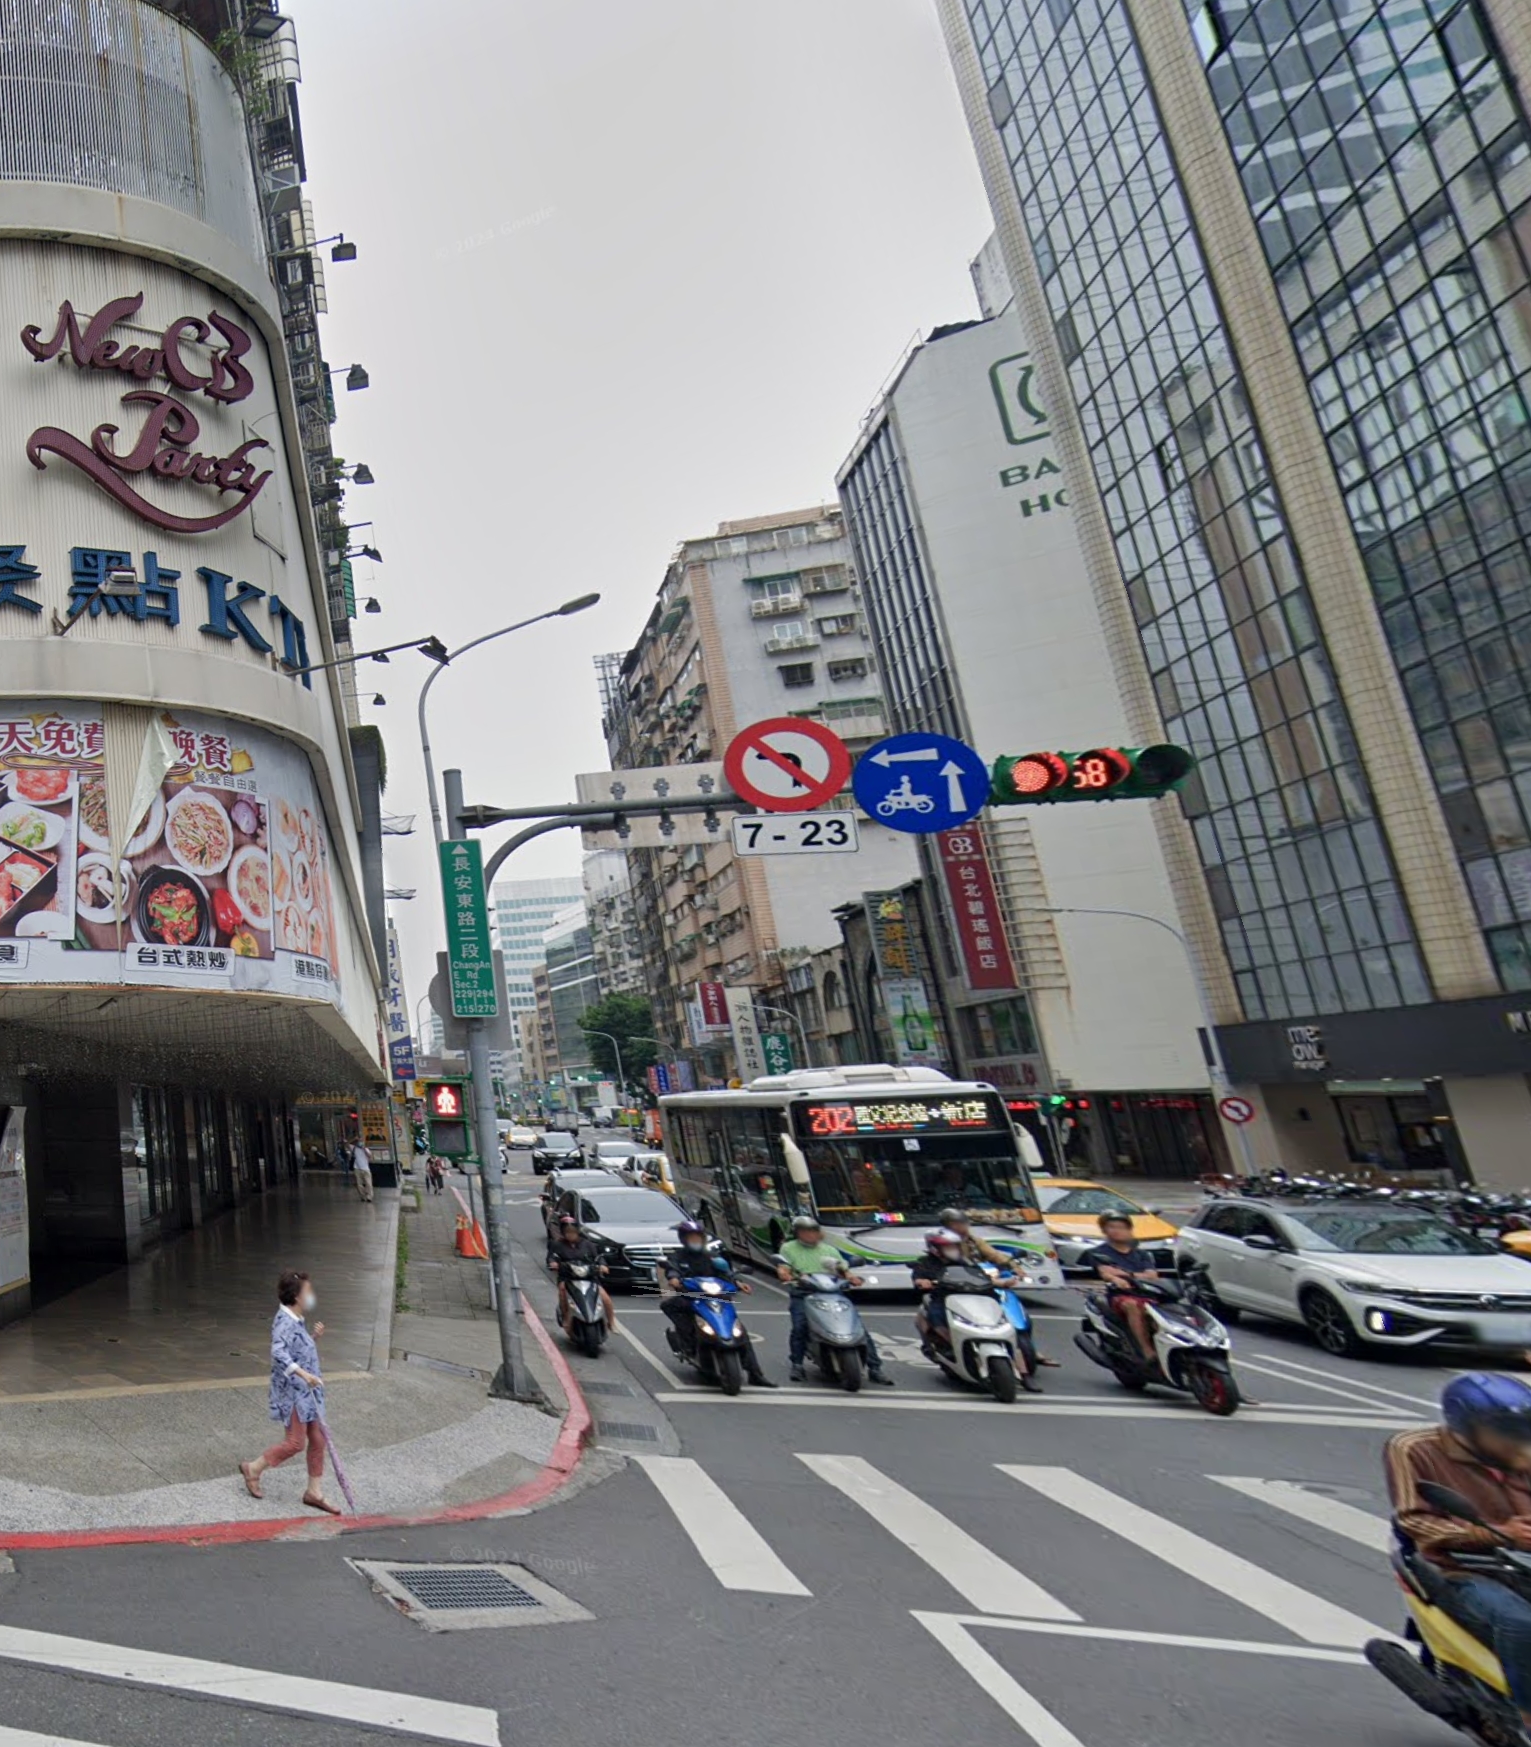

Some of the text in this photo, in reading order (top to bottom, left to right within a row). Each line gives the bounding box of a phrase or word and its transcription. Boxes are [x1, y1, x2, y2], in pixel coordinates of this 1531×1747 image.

[26, 389, 274, 534] Party
[452, 856, 480, 958] 長安東路二段
[958, 866, 998, 968] 台北碧瑤飯店
[137, 946, 229, 969] 台式熱炒
[452, 961, 491, 972] ChangAn
[454, 980, 479, 988] Sec.2
[455, 989, 494, 998] 229 294
[457, 1005, 497, 1013] 215 270
[394, 1046, 410, 1056] 5F
[808, 1107, 857, 1135] 202
[940, 1100, 987, 1121] 新店
